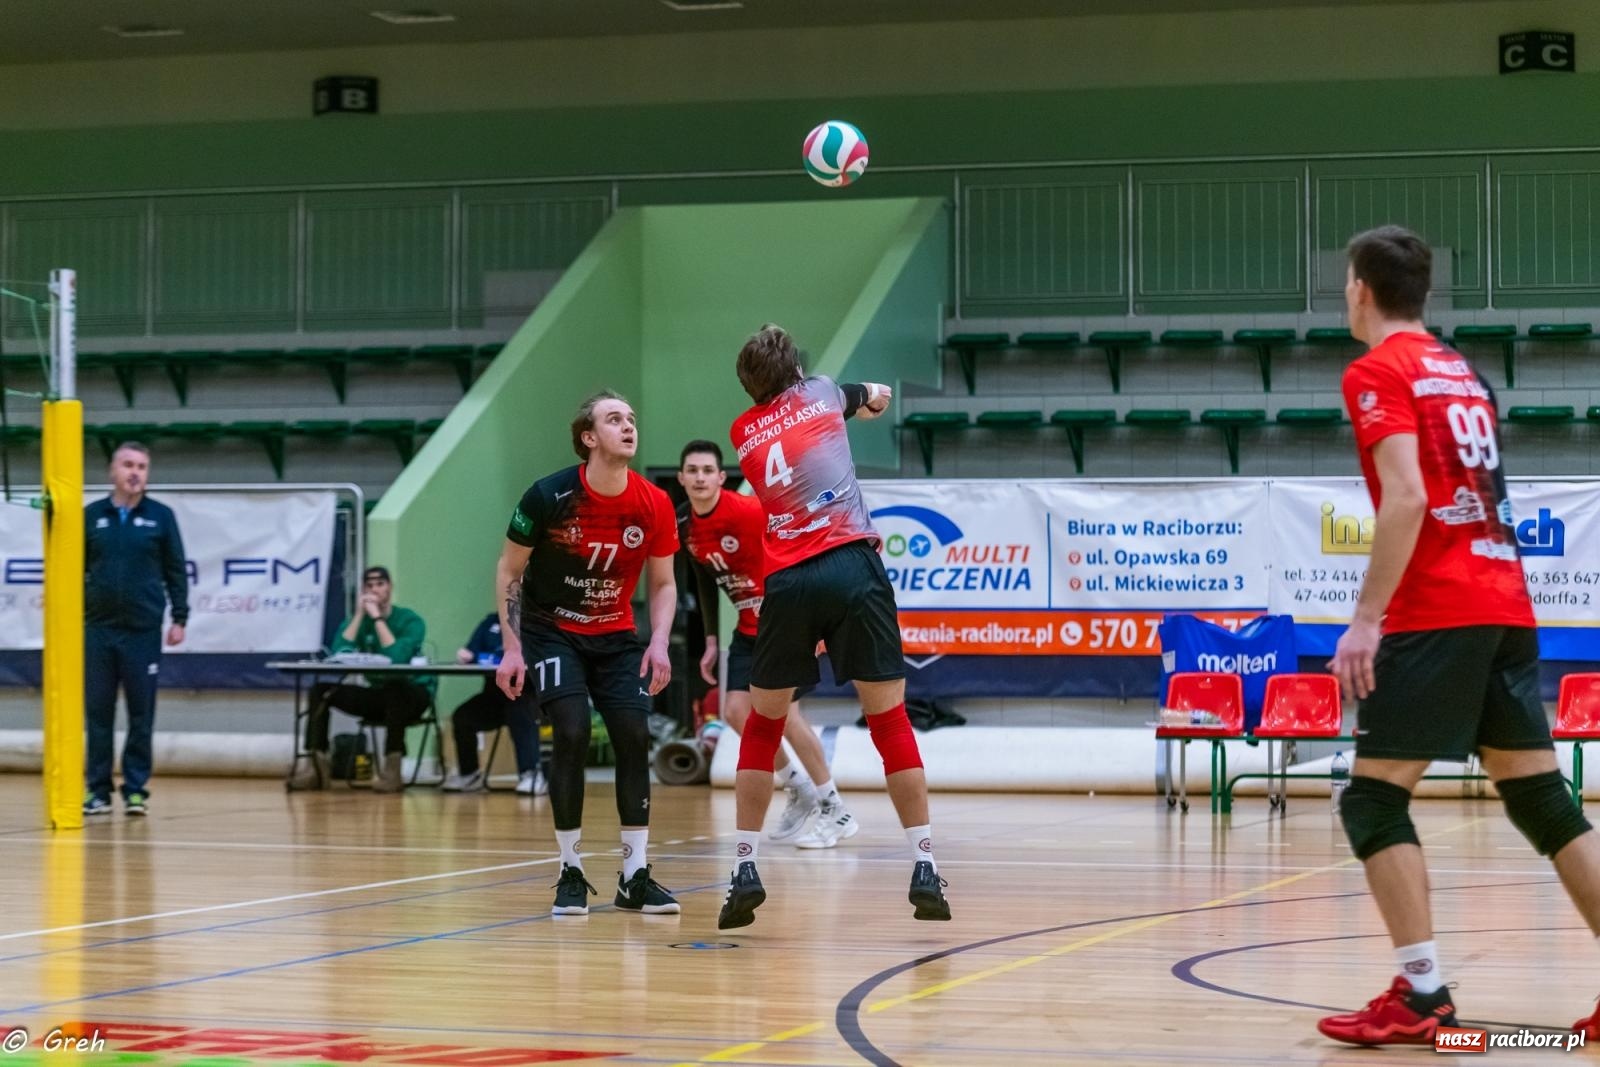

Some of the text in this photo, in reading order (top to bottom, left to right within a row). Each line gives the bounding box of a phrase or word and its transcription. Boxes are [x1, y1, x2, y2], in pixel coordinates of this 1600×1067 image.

[1504, 45, 1525, 68] C
[1542, 44, 1568, 67] C
[341, 88, 367, 109] B
[744, 401, 791, 437] KS VOLLEY
[738, 423, 782, 462] ASTECZKO
[1446, 402, 1500, 470] 99
[765, 440, 793, 488] 4
[1068, 519, 1243, 536] Biura w Raciborzu:
[1321, 501, 1376, 555] ins
[1516, 508, 1565, 556] ch
[586, 542, 618, 572] 77
[945, 545, 1030, 564] MULTI
[1086, 549, 1228, 568] ul. Opawska 69
[223, 557, 320, 585] FM
[886, 568, 1031, 591] PIECZENIA
[1284, 568, 1306, 581] tel.
[1311, 569, 1327, 582] 32
[1332, 570, 1358, 582] 414
[1543, 571, 1569, 585] 363
[1574, 571, 1600, 584] 647
[1086, 575, 1244, 591] ul. Mickiewicza 3
[1294, 589, 1347, 602] 47-400
[1583, 592, 1590, 605] 2
[901, 622, 1053, 648] czenia-raciborz.pl
[1089, 618, 1138, 648] 570
[535, 656, 560, 692] 77
[1197, 651, 1277, 675] molten
